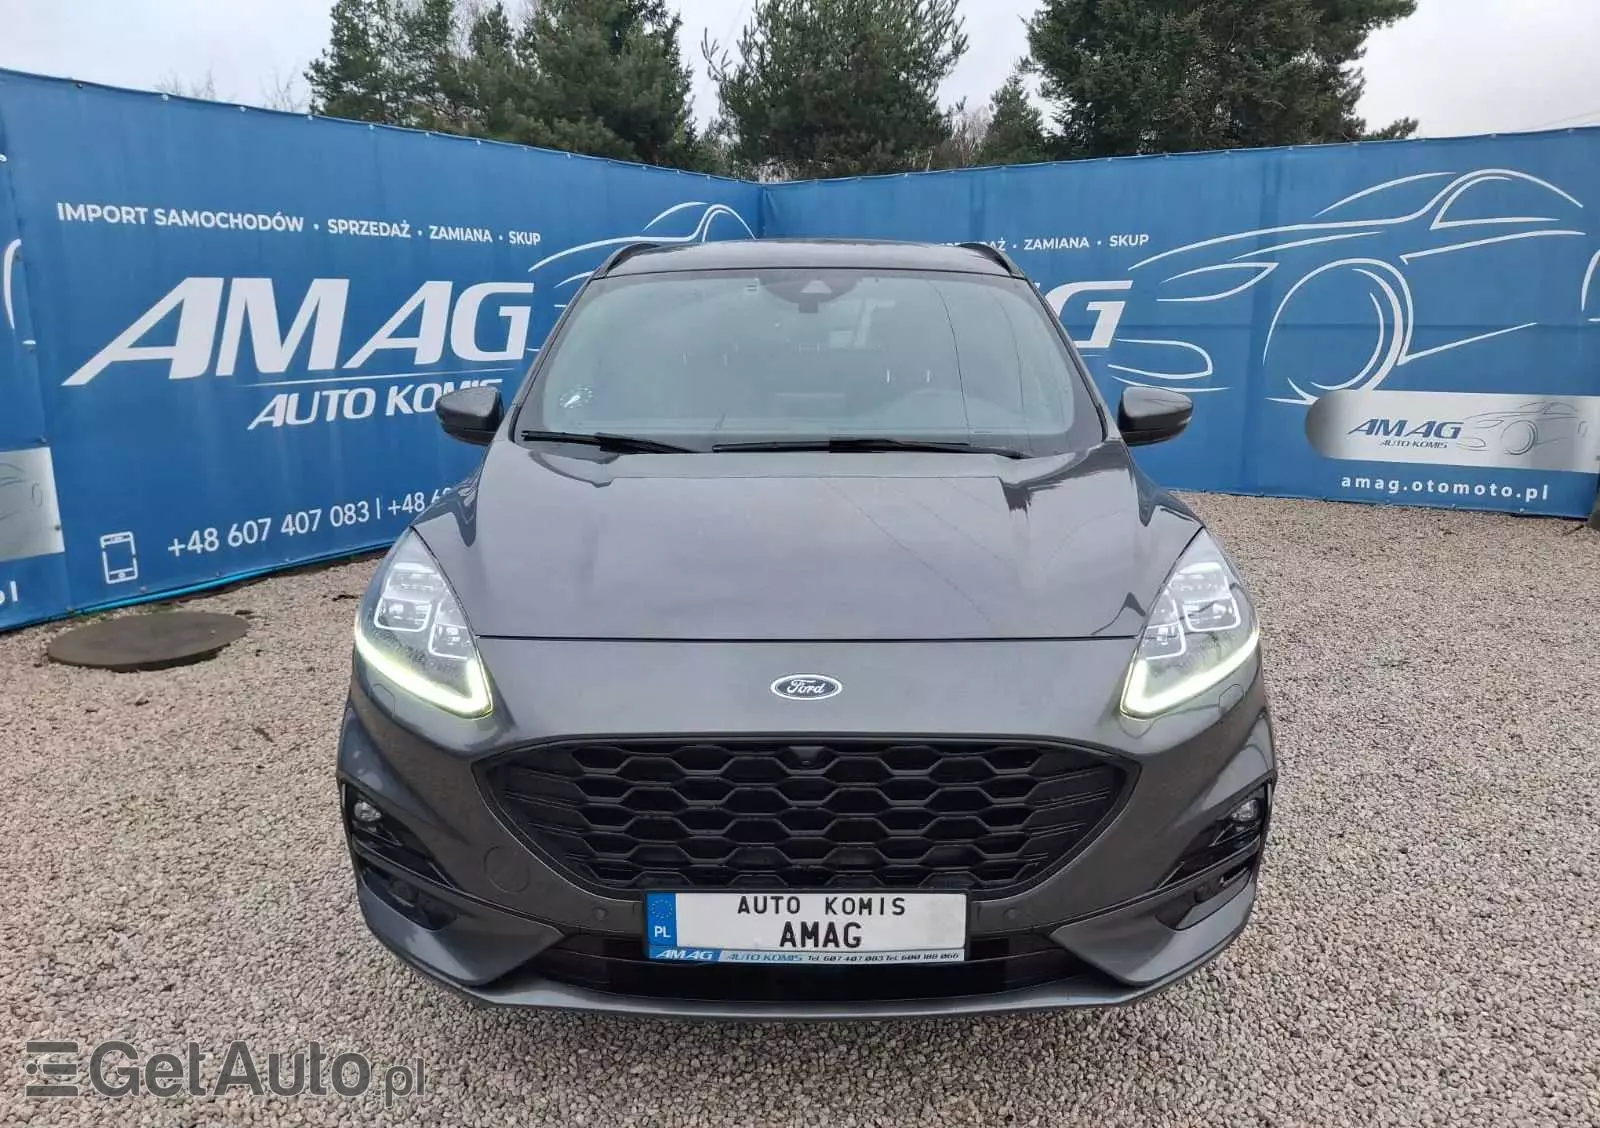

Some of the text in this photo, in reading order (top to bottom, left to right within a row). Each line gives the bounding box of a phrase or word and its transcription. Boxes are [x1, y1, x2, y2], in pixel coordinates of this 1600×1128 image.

[56, 202, 541, 246] IMPORT SAMOCHODÓW SPRZEDAŻ ZAMIANA SKUP
[1023, 234, 1149, 251] ZAMIANA SKUP
[247, 387, 376, 430] AUTO
[1380, 439, 1448, 449] AUTO KOMIS
[1341, 475, 1549, 502] amag.otomoto.pl
[167, 527, 220, 557] +48
[227, 518, 272, 548] 607
[280, 509, 323, 537] 407
[330, 500, 370, 528] 083
[387, 491, 426, 516] +48
[786, 679, 826, 694] Ford
[737, 896, 906, 916] AUTO KOMIS
[654, 926, 671, 938] PL
[779, 921, 863, 948] AMAG
[727, 953, 761, 961] AUTO
